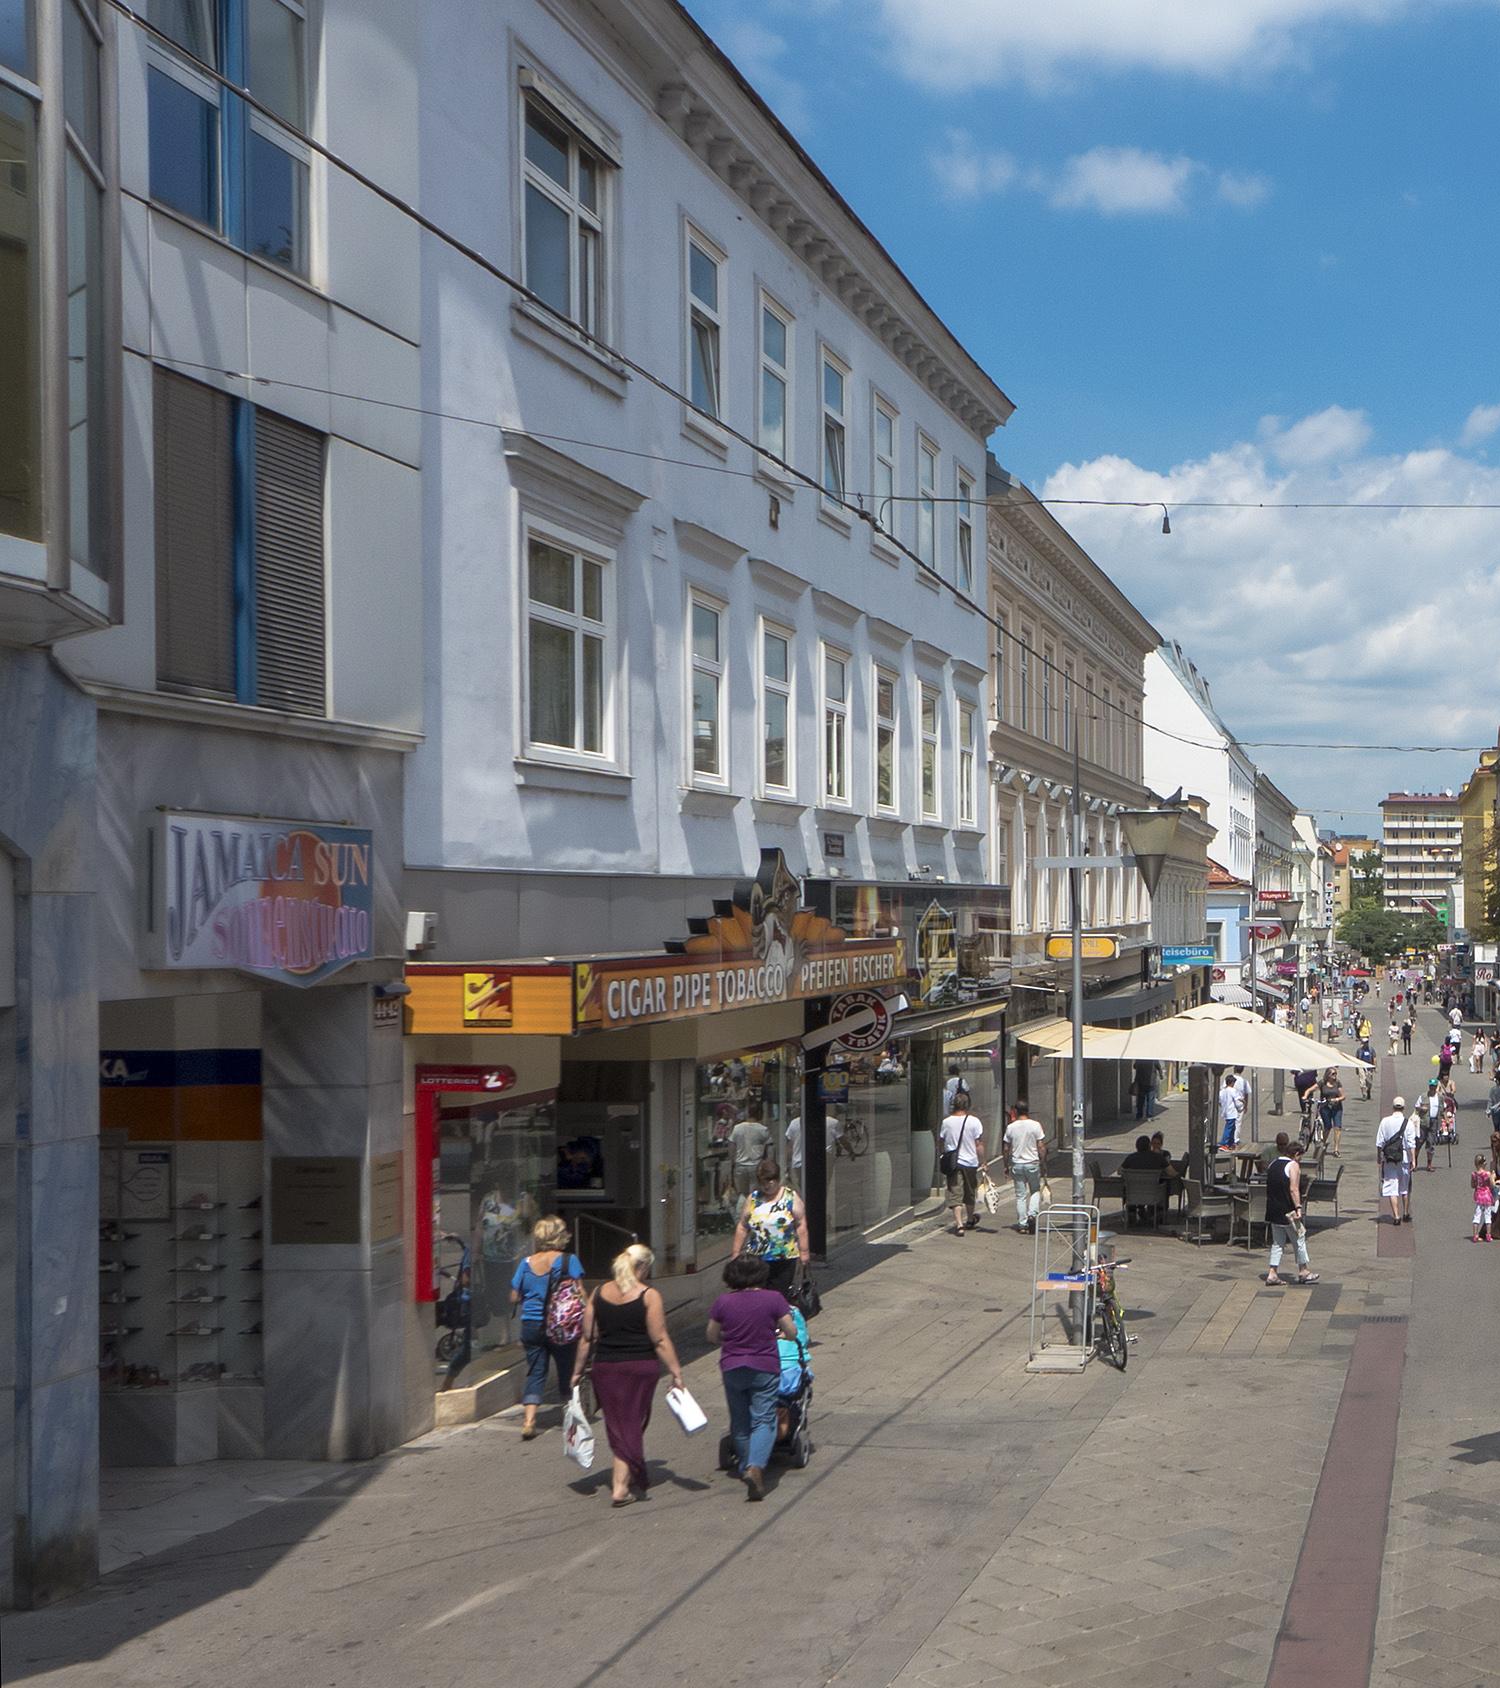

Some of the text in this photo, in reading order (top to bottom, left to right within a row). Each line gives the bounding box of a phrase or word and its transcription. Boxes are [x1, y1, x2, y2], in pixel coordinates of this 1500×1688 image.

[168, 824, 370, 961] JAMAICA SUN
[607, 953, 895, 1020] CIGAR PIPE TOBACCO PFEIFEN FISCHER
[832, 993, 877, 1019] TABAK
[847, 1014, 887, 1047] TRAFIK
